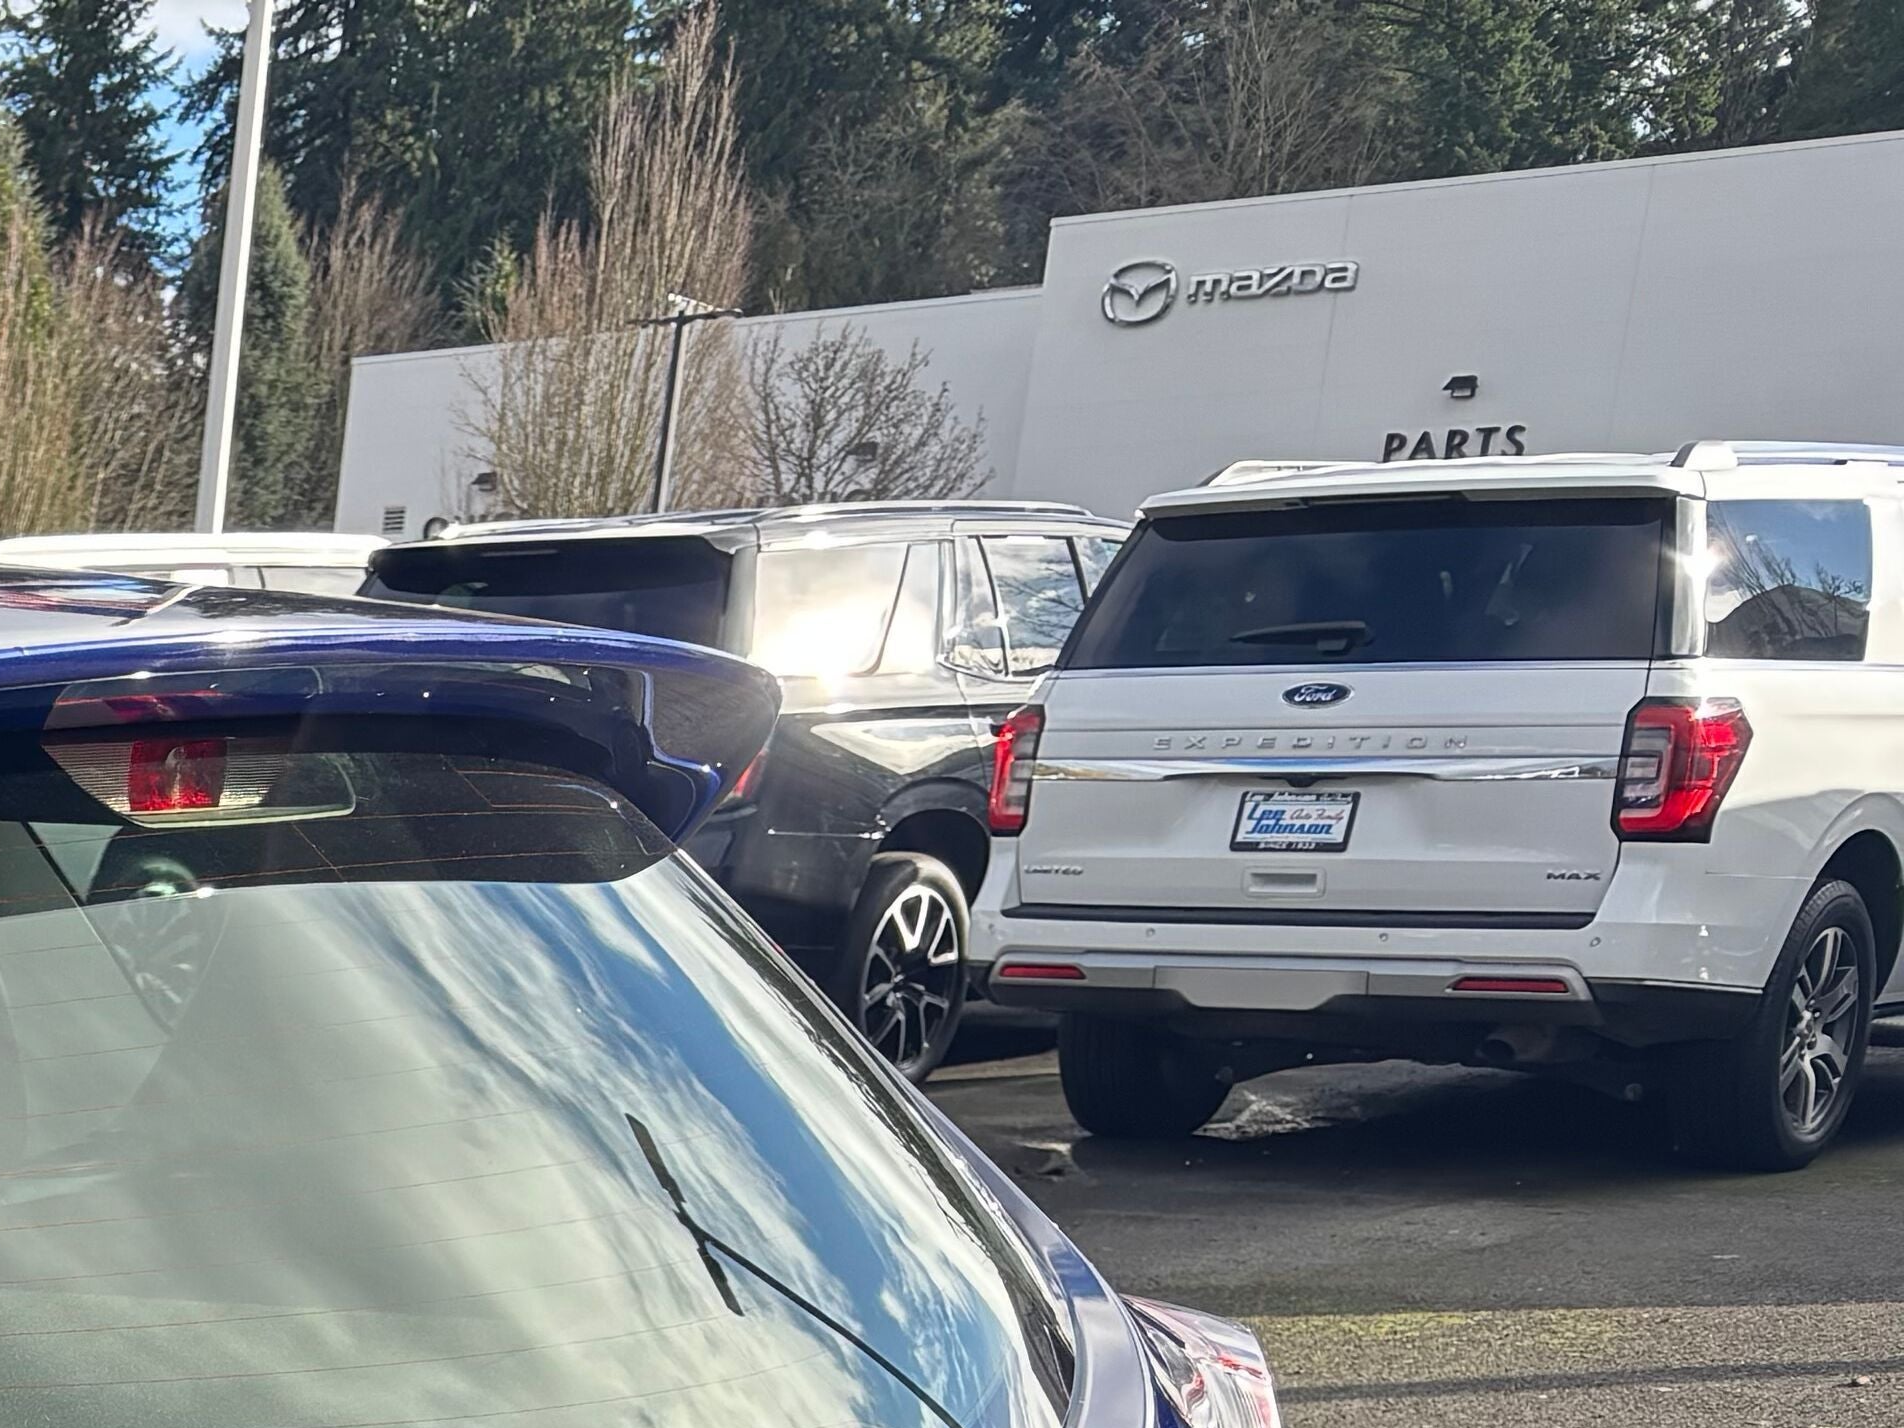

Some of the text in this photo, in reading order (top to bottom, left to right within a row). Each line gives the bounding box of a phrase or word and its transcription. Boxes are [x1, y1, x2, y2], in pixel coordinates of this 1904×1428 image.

[1383, 424, 1527, 463] PARTS
[1293, 684, 1337, 703] Ford
[1153, 734, 1469, 750] EXPEDITION
[1247, 802, 1287, 821] Lee
[1290, 808, 1313, 821] Auto
[1245, 819, 1333, 834] Johnson
[1546, 869, 1601, 881] MAX
